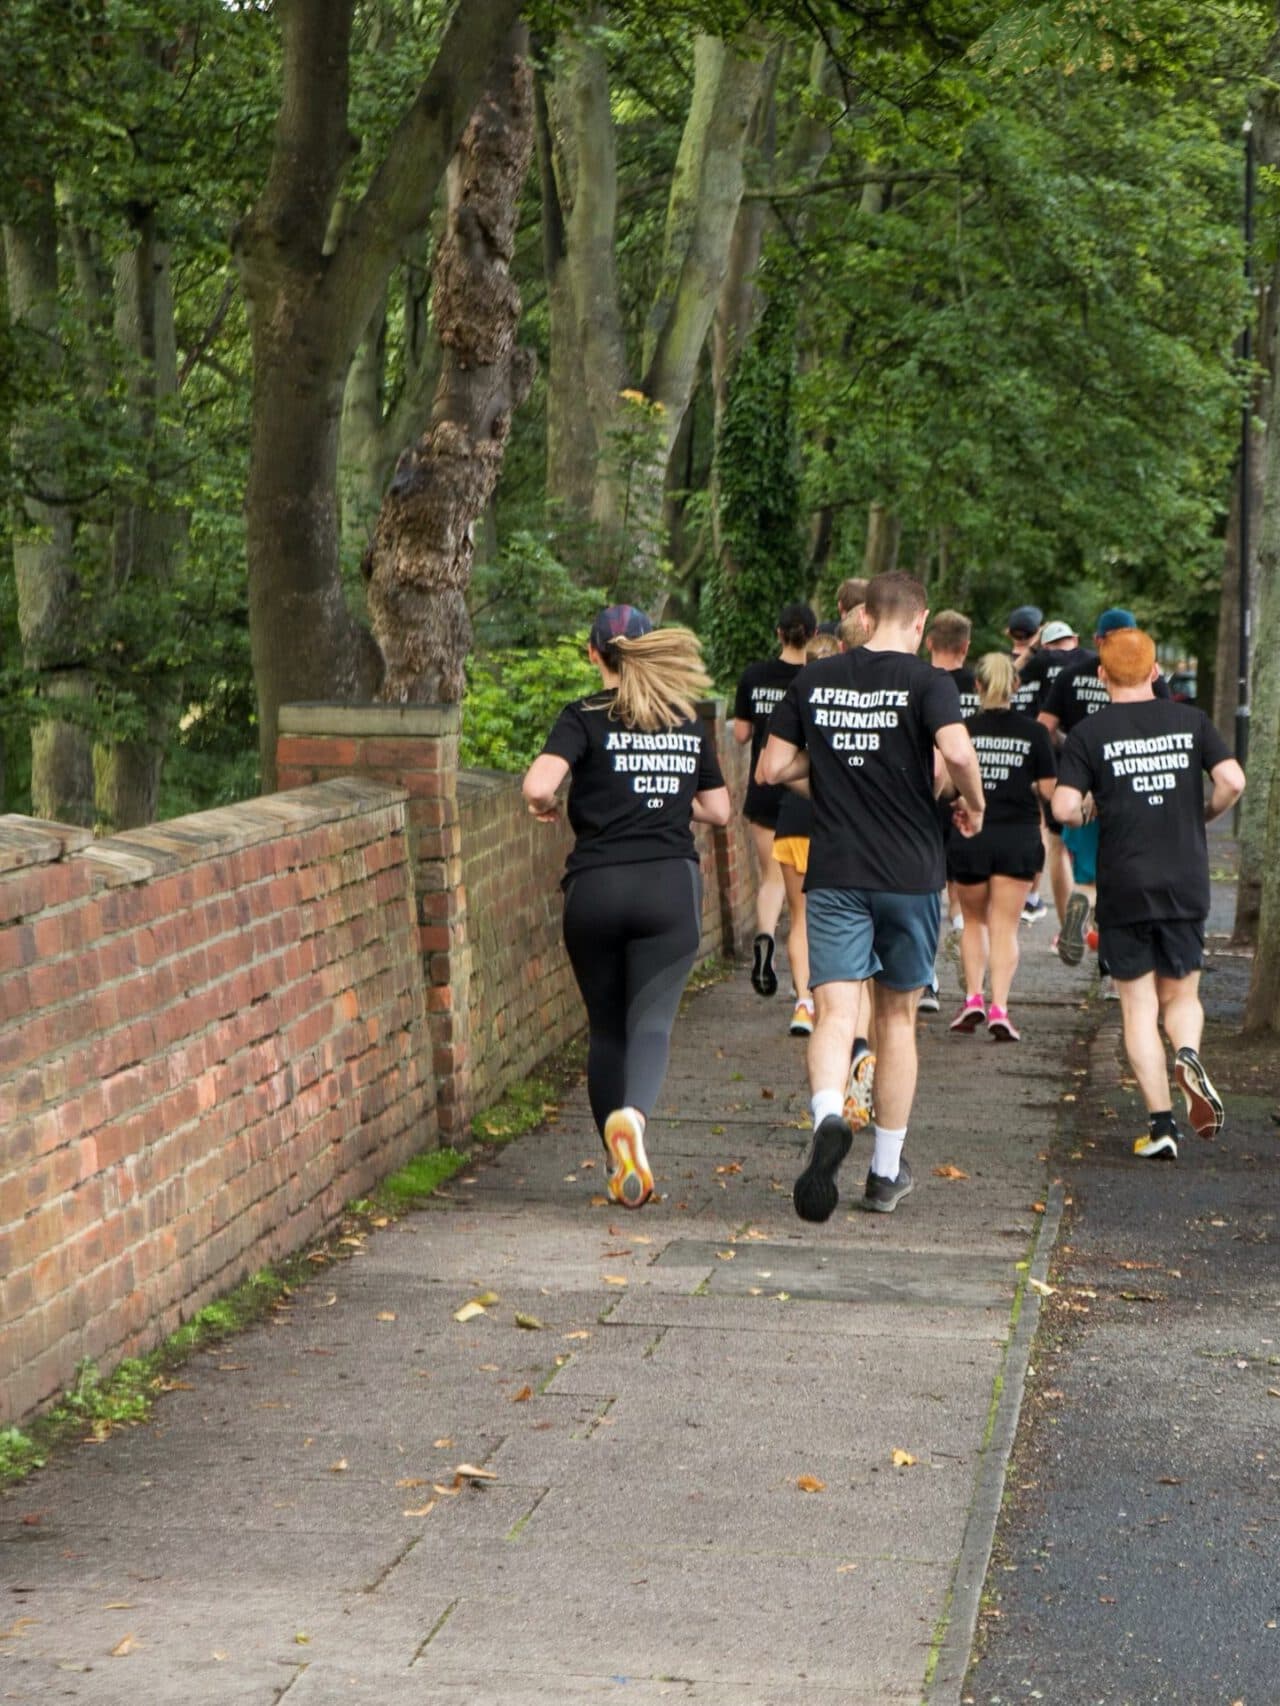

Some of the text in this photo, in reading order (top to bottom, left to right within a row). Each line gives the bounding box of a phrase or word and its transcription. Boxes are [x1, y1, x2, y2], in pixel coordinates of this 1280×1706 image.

[809, 687, 910, 708] APHRODITE
[814, 709, 899, 728] RUNNING
[606, 732, 701, 754] APHRODITE
[832, 732, 880, 751] CLUB
[1103, 733, 1194, 761] APHRODITE
[614, 754, 696, 774] RUNNING
[1111, 753, 1189, 777] RUNNING
[634, 776, 680, 794] CLUB
[1132, 773, 1176, 792] CLUB
